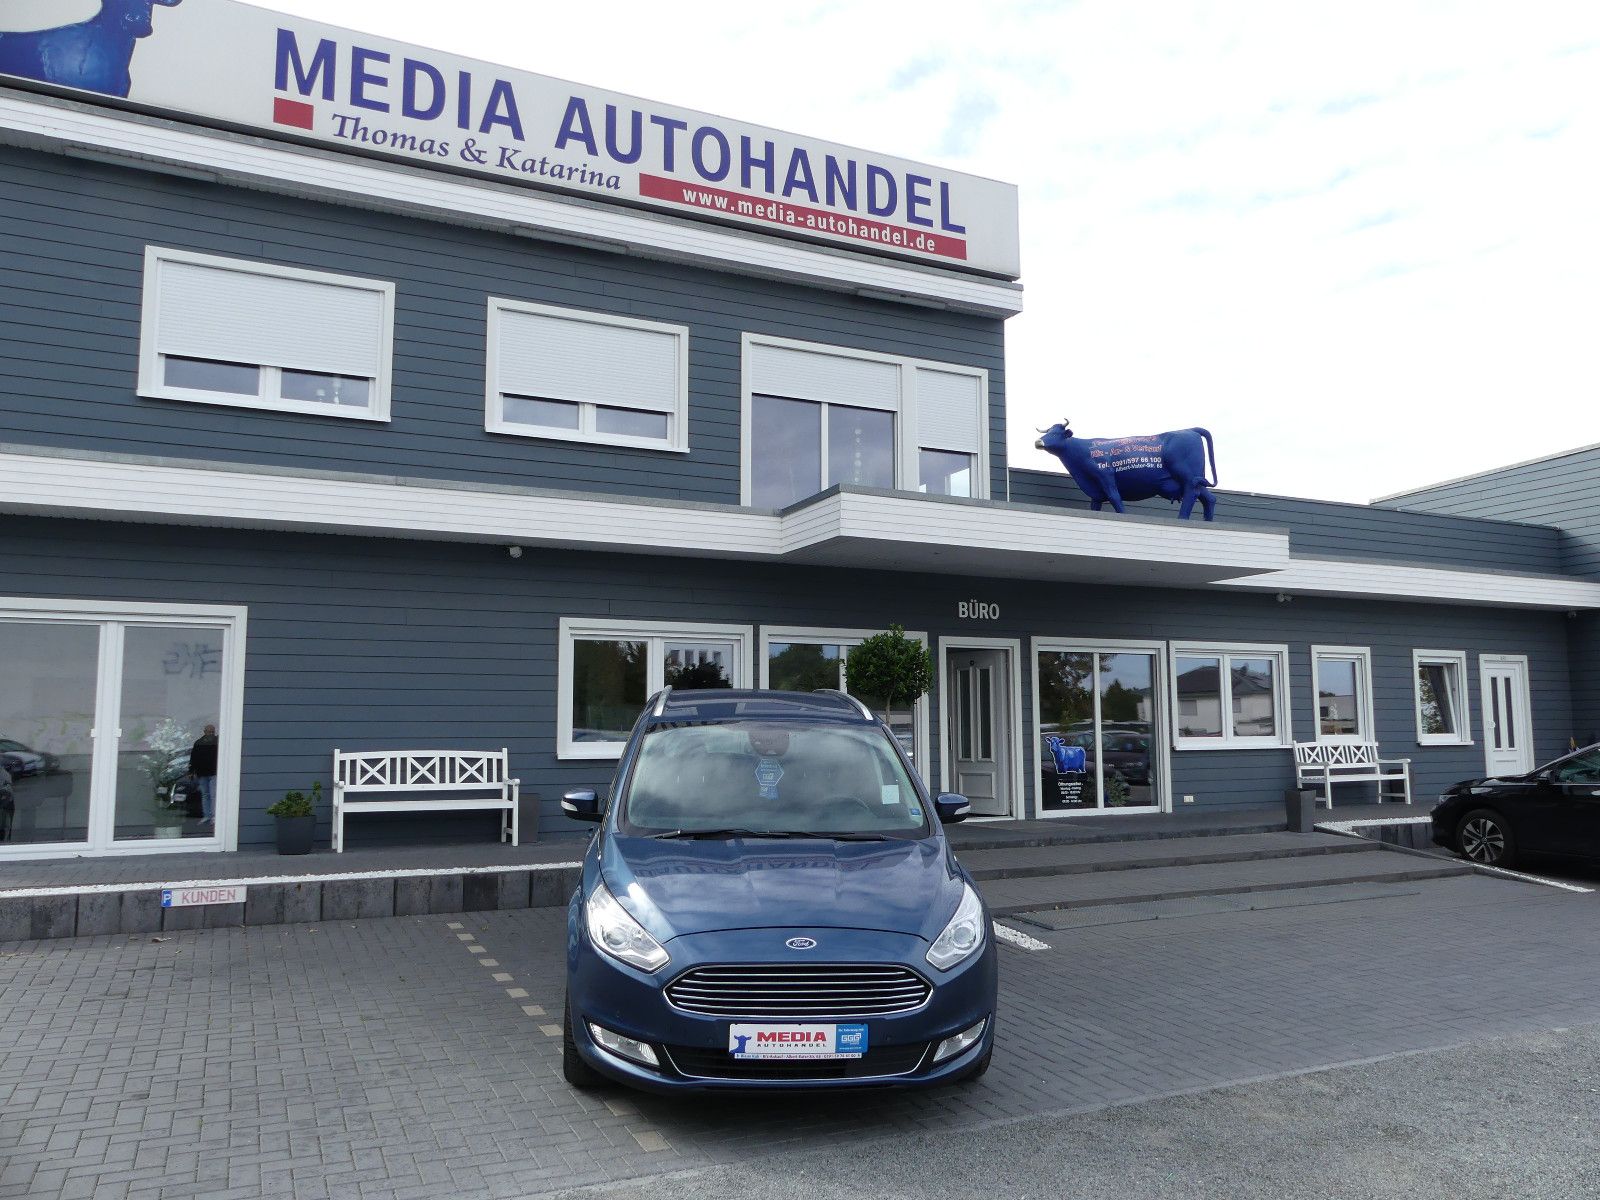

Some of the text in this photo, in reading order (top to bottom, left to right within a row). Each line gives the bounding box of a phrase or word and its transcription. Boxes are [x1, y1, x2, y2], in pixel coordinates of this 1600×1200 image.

[274, 27, 966, 235] MEDIA AUTOHANDEL
[332, 113, 622, 191] Thomas & Katarina
[682, 187, 937, 253] www.media-autohandel.de
[958, 599, 1000, 620] BÜRO
[163, 889, 236, 904] P KUNDEN
[757, 1031, 827, 1042] MEDIA
